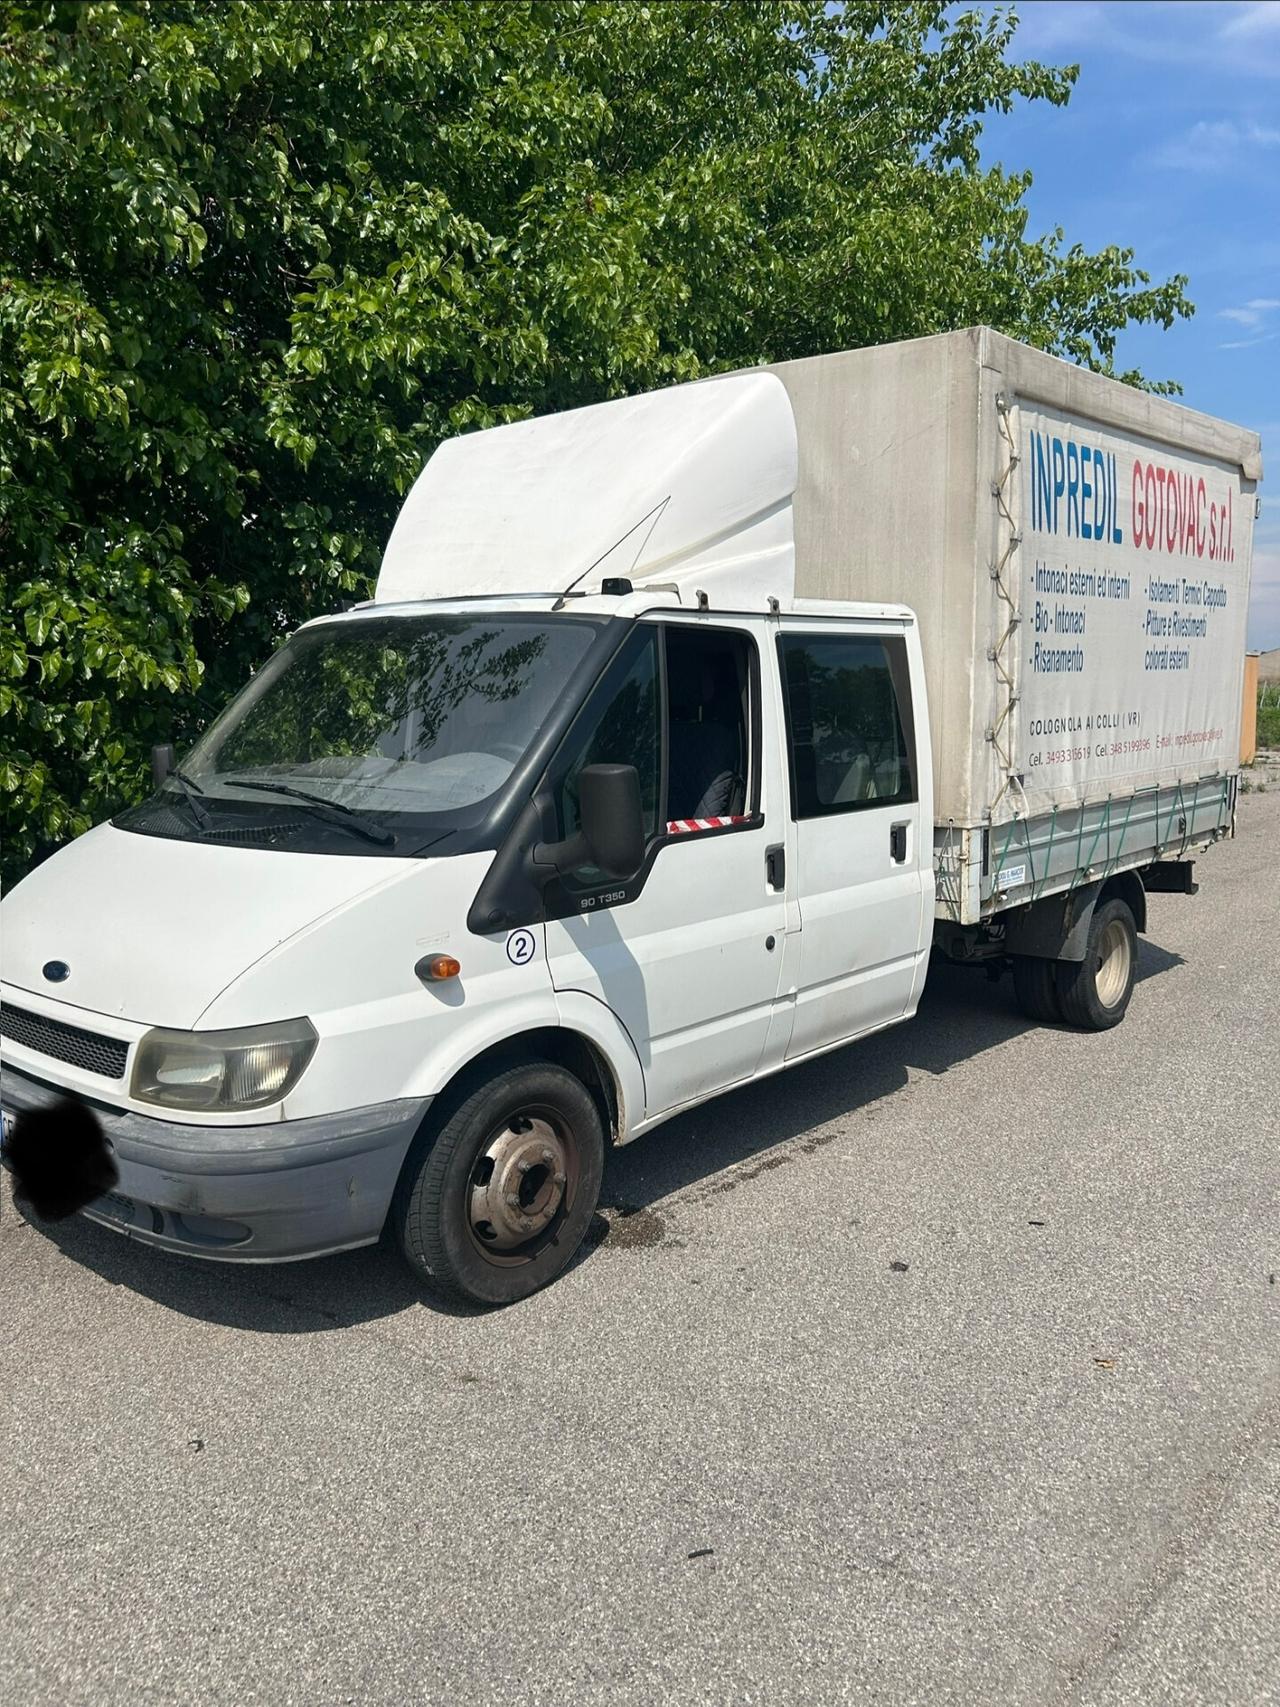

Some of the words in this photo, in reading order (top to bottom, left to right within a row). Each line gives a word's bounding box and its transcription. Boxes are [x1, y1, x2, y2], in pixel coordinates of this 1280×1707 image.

[1030, 429, 1122, 544] INPREDIL
[1132, 459, 1206, 559] GOTOVAC
[1209, 486, 1234, 562] s.r.l.
[1036, 560, 1068, 594] Intonaci
[1069, 566, 1096, 596] esterni
[1097, 569, 1106, 598] ed
[1107, 569, 1130, 600] interni
[1149, 574, 1179, 604] Isolamenti
[1182, 578, 1202, 605] Termici
[1203, 581, 1227, 612] Cappotto
[1035, 601, 1048, 632] Bio
[1055, 602, 1086, 634] Intonaci
[1146, 609, 1167, 637] Pitture
[1167, 617, 1172, 637] e
[1172, 610, 1207, 637] Rivestimenti
[1034, 641, 1083, 673] Risanamento
[1145, 643, 1169, 670] colorati
[1169, 644, 1190, 670] esterni
[1029, 716, 1082, 736] COLOGNOLA
[1086, 715, 1093, 730] AI
[1096, 713, 1119, 729] COLLI
[1029, 752, 1043, 767] Cel.
[580, 897, 596, 909] 90
[598, 890, 626, 904] T350
[515, 937, 528, 958] 2
